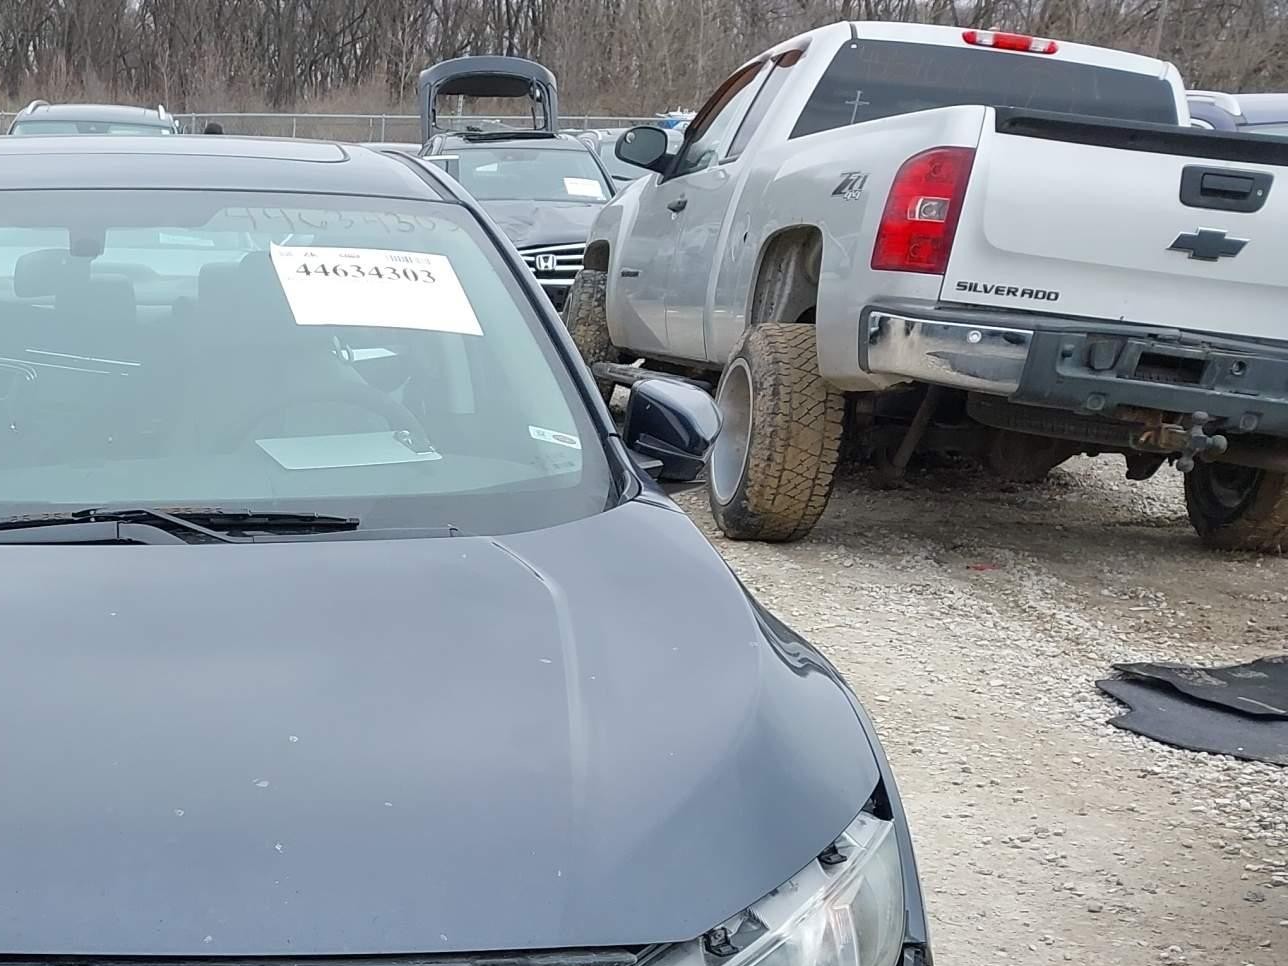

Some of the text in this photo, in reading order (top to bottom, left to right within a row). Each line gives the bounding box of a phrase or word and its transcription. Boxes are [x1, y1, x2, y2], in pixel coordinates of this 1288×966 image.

[832, 171, 869, 195] Z71
[296, 263, 437, 284] 44634303
[955, 281, 1060, 301] SILVERADO
